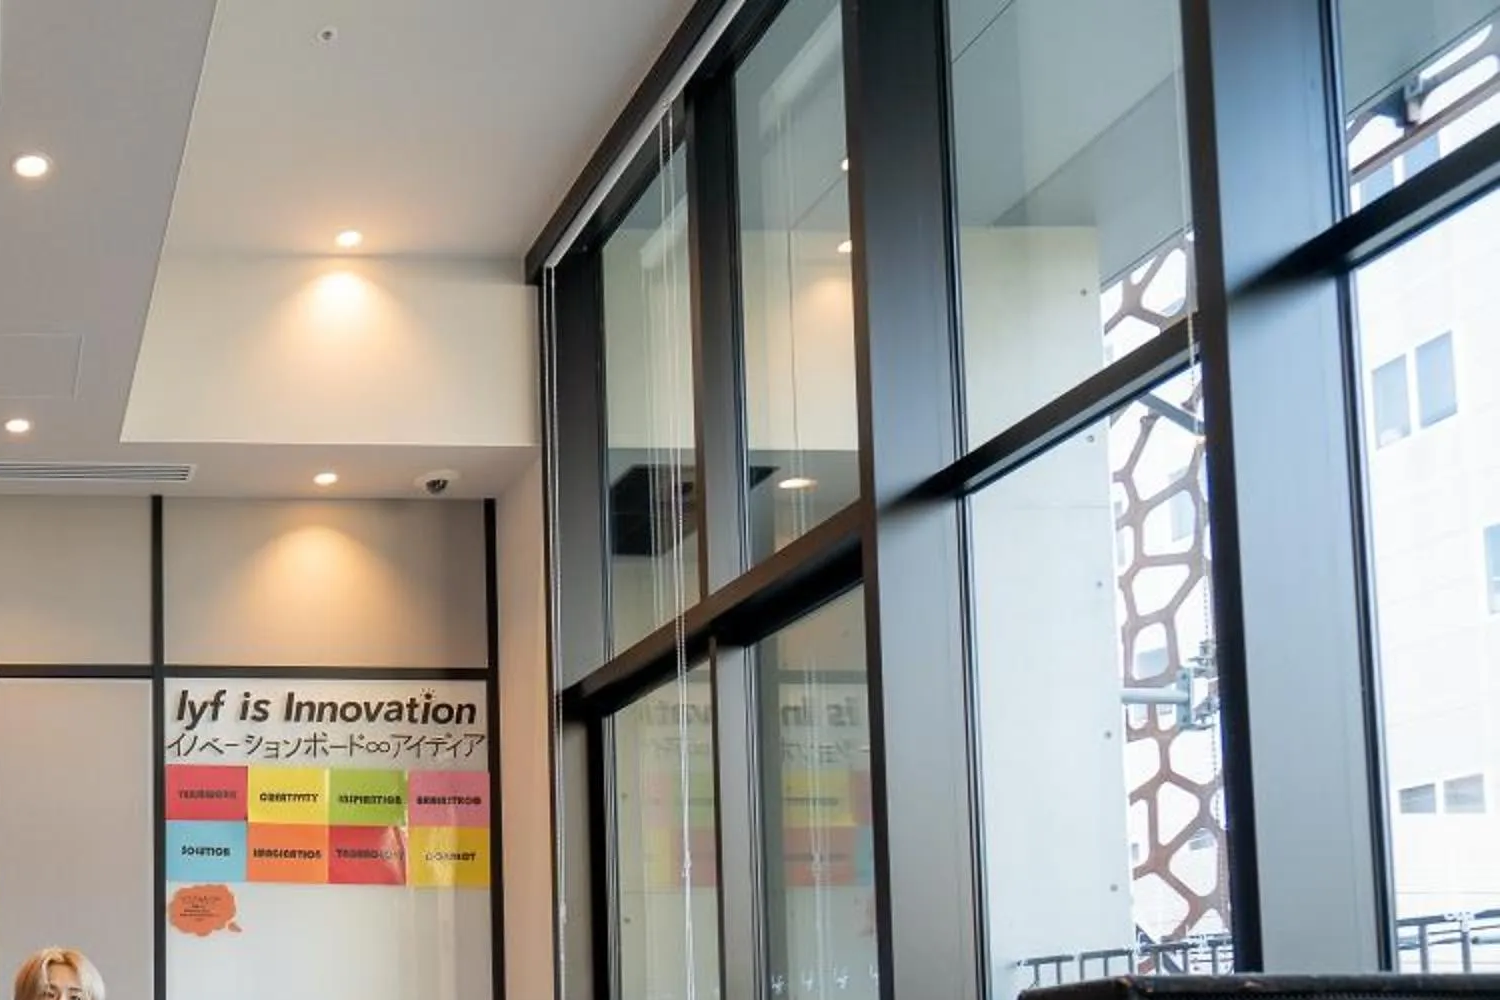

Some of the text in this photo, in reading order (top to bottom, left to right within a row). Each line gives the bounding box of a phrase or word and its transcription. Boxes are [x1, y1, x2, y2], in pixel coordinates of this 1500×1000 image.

[177, 688, 476, 731] lyf is Innovation
[259, 792, 319, 803] CREATIVITY
[181, 844, 231, 857] SOLUTION
